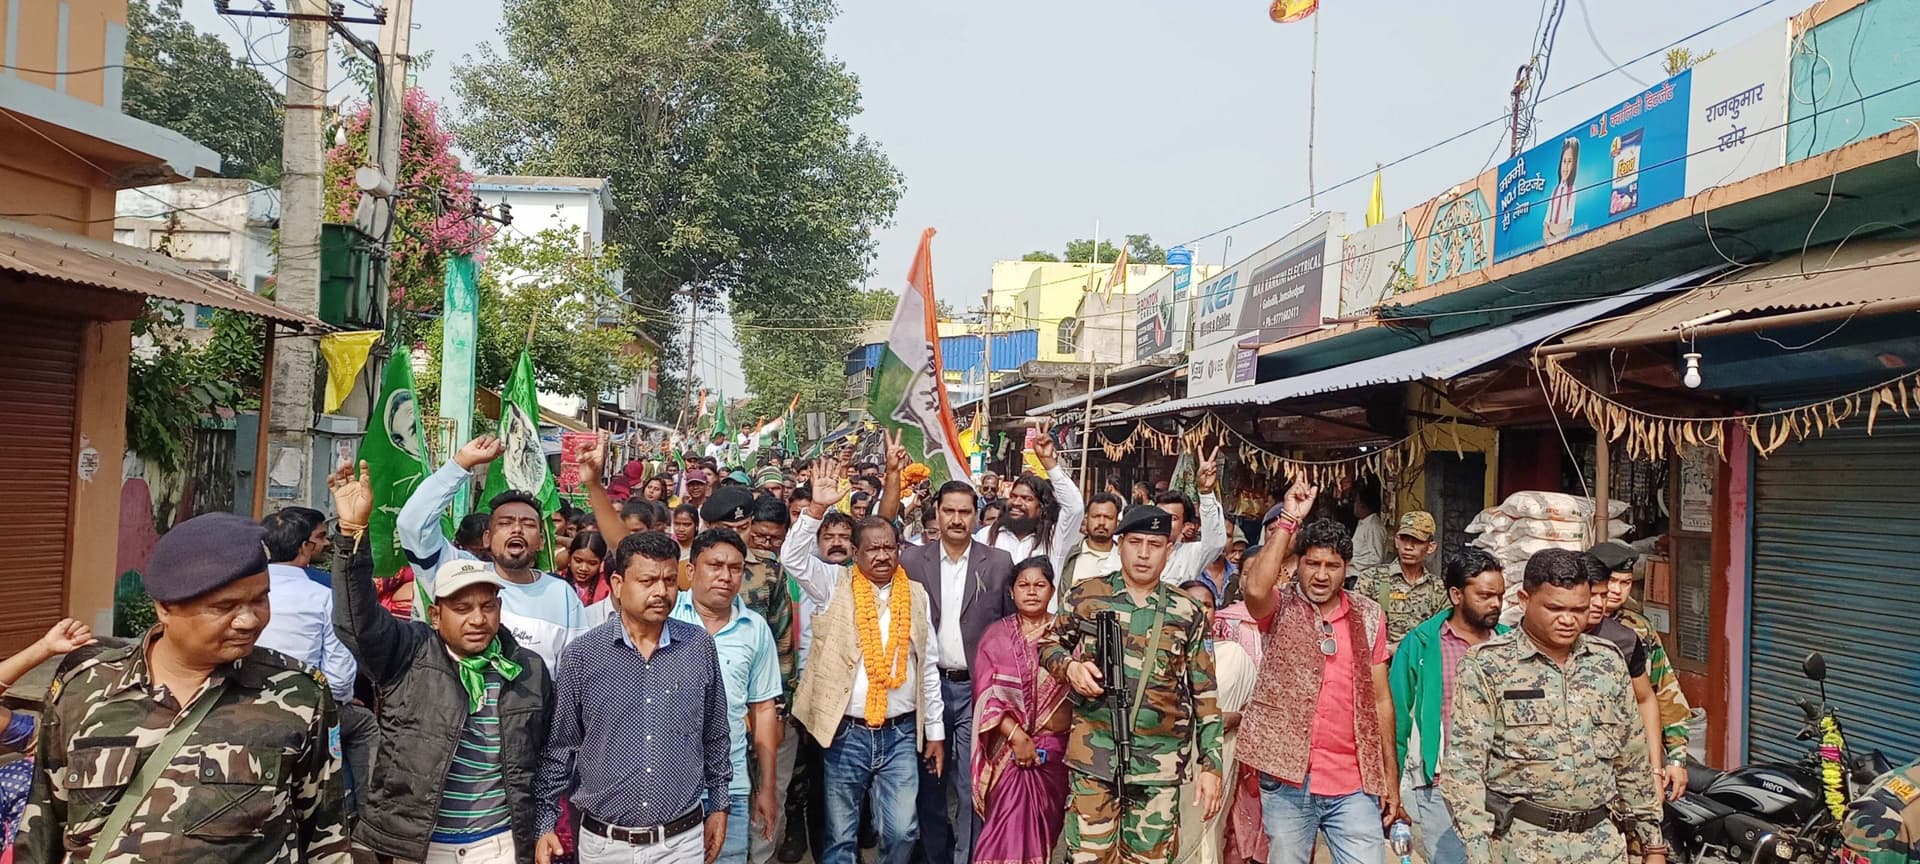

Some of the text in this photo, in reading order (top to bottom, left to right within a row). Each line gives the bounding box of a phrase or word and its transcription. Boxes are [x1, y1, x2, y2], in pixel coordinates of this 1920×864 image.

[1705, 82, 1765, 122] राजकुमार
[1718, 124, 1747, 152] स्टोर
[1287, 253, 1322, 281] ELECTRICAL
[1201, 270, 1239, 318] KEI
